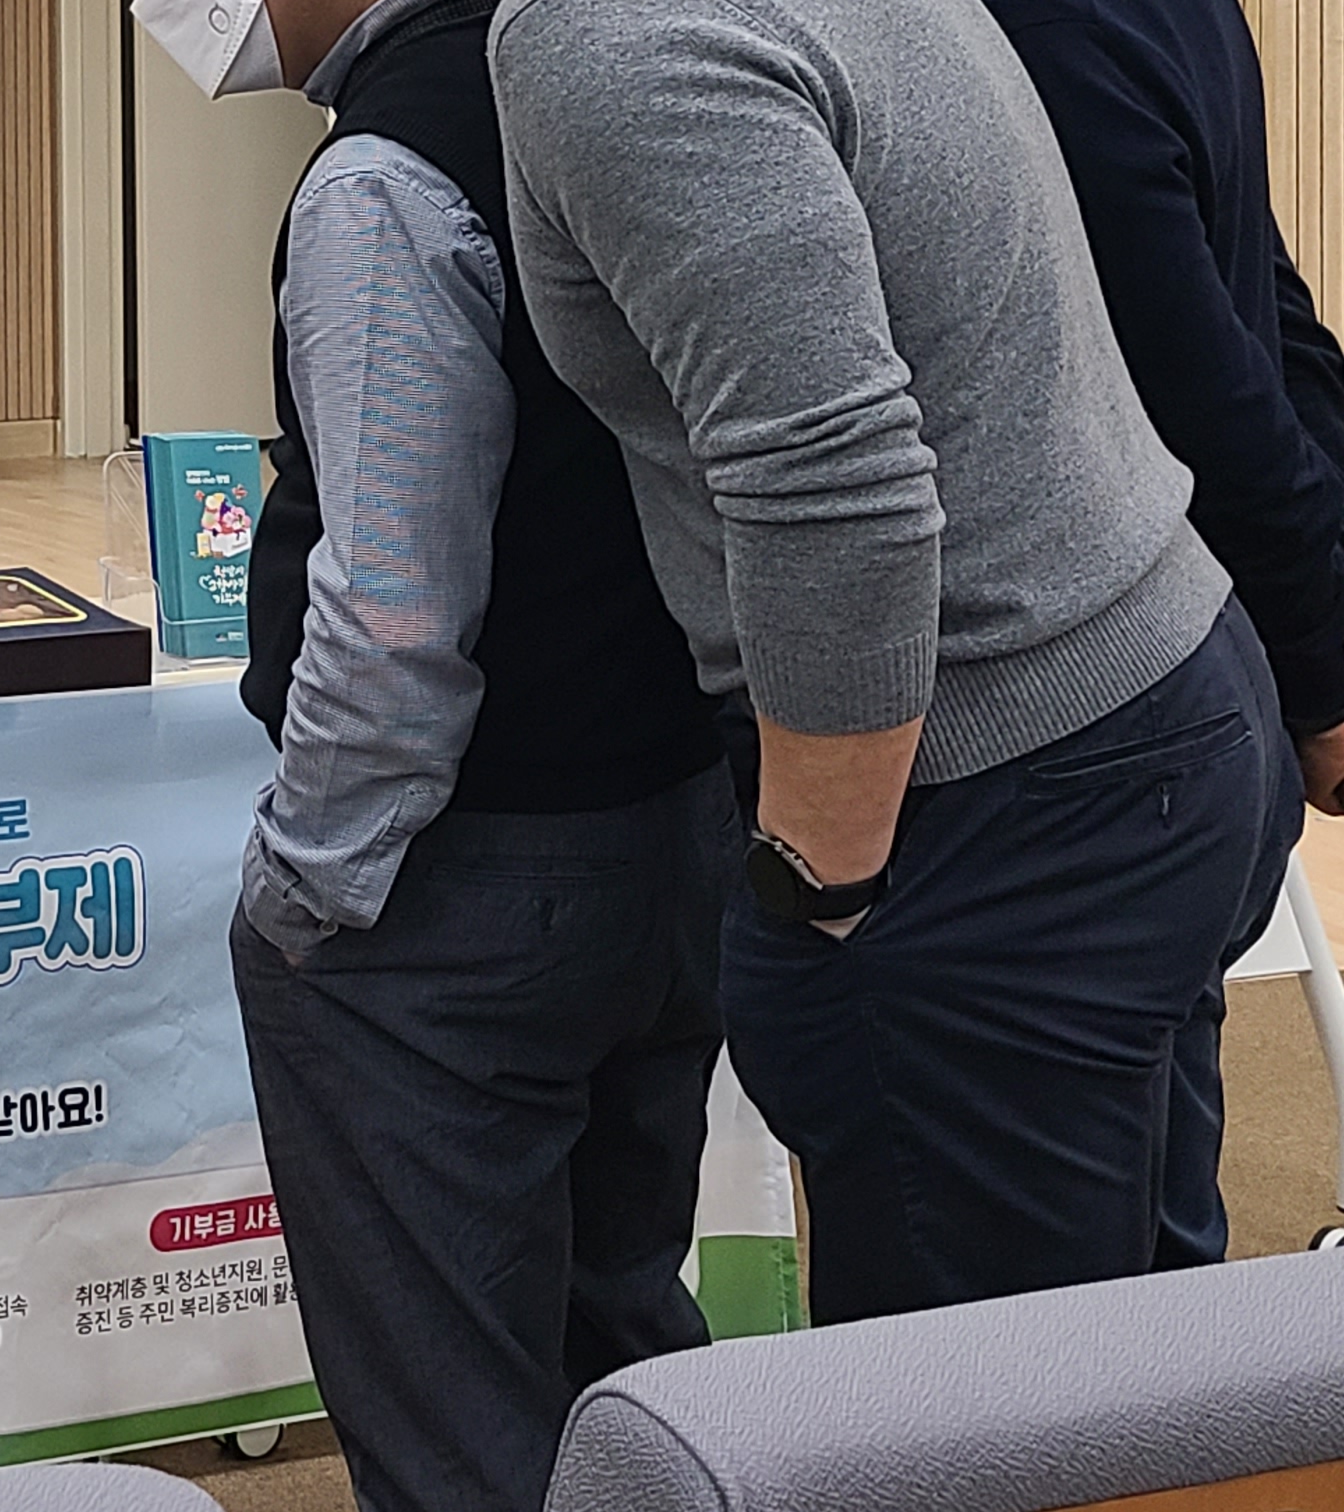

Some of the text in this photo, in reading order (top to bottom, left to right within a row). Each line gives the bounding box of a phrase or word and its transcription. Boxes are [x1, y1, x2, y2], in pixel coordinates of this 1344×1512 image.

[169, 1208, 236, 1243] 기부금
[75, 1274, 149, 1307] 취약계층
[153, 1271, 170, 1296] 및
[175, 1258, 268, 1292] 청소년지원,
[75, 1307, 112, 1335] 증진
[116, 1305, 134, 1330] 등
[139, 1298, 175, 1325] 주민
[179, 1285, 268, 1320] 복리증진에
